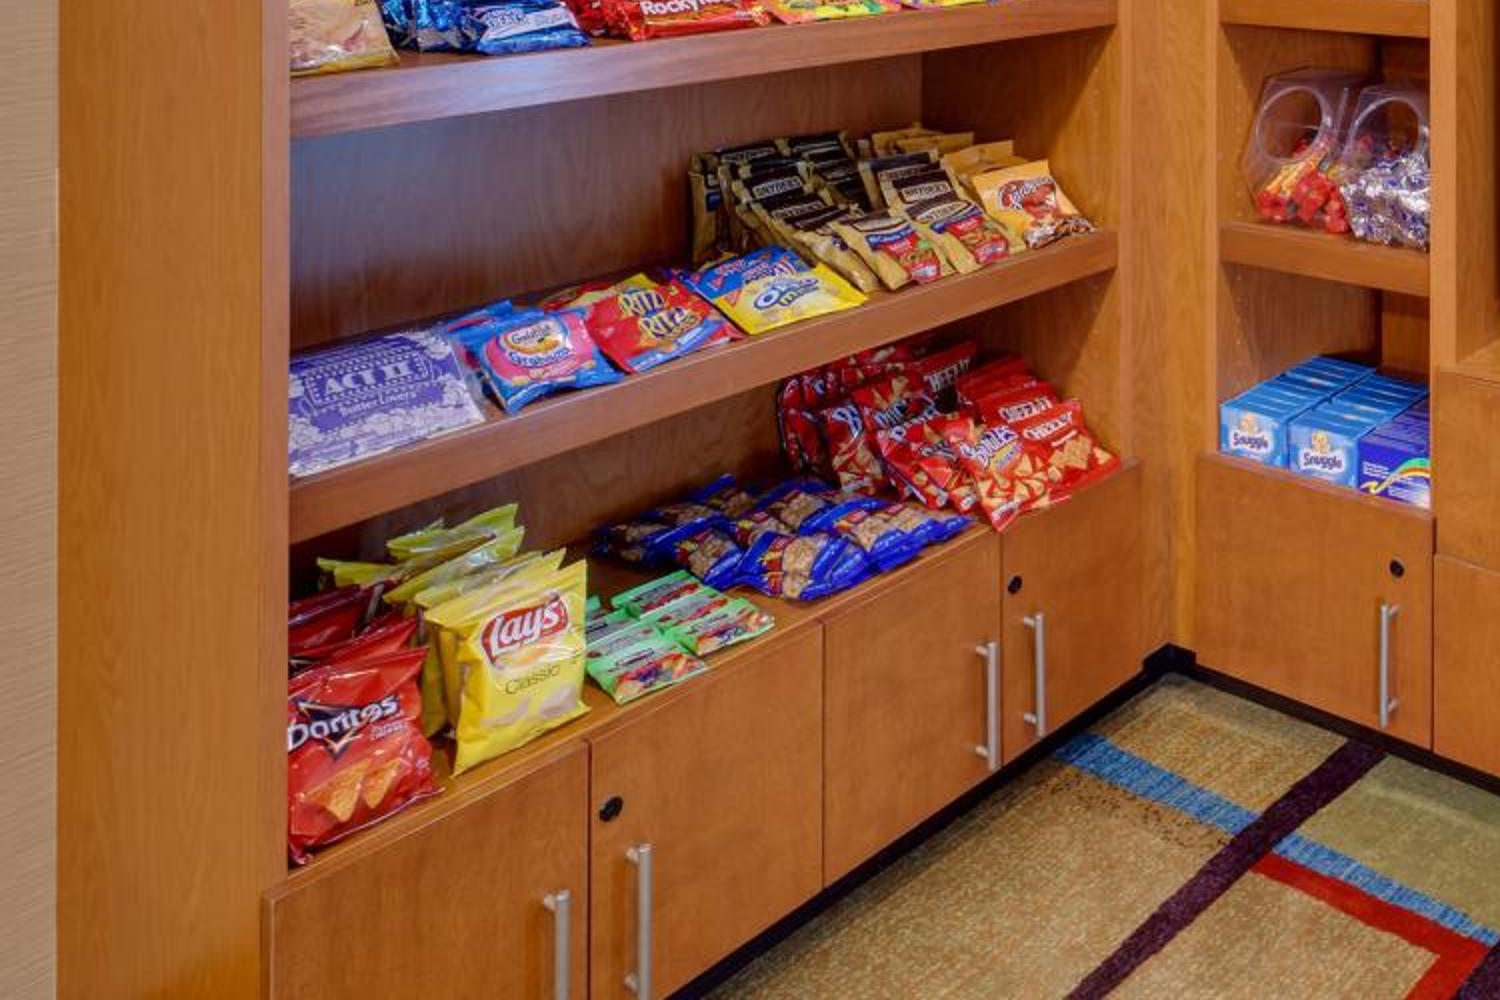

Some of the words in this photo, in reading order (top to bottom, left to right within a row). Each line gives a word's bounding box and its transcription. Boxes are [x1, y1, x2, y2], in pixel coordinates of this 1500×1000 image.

[754, 278, 818, 311] OREO
[324, 369, 375, 395] ACT
[382, 359, 413, 383] II
[1233, 433, 1269, 449] Snuggle
[1303, 453, 1343, 470] Snuggle
[488, 597, 563, 655] Lay's
[504, 661, 562, 695] Classic
[288, 695, 400, 752] Doritos
